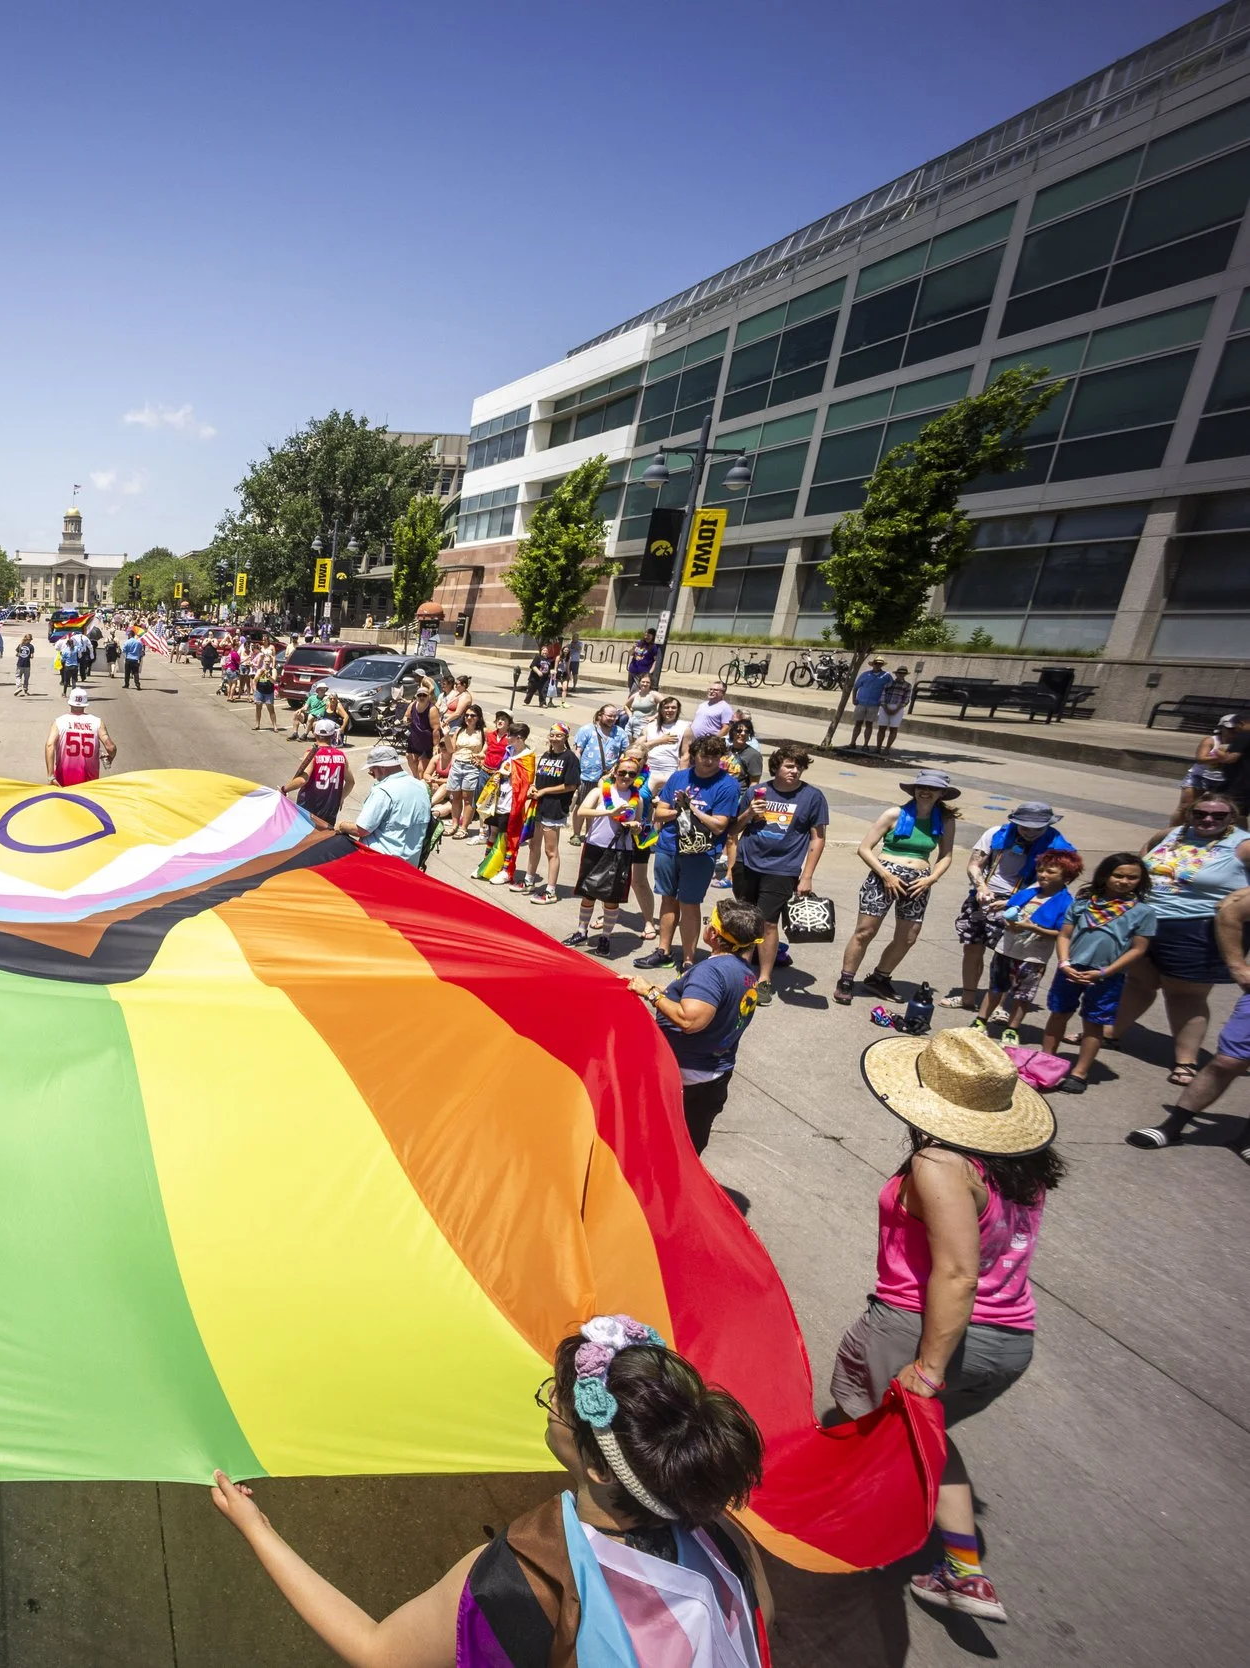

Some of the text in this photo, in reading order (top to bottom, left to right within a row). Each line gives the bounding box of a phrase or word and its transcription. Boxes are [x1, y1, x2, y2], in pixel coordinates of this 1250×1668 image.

[690, 518, 718, 578] IOWA
[318, 562, 328, 588] IOWA
[66, 732, 95, 758] 55
[554, 759, 564, 769] ALL
[316, 765, 341, 790] 34
